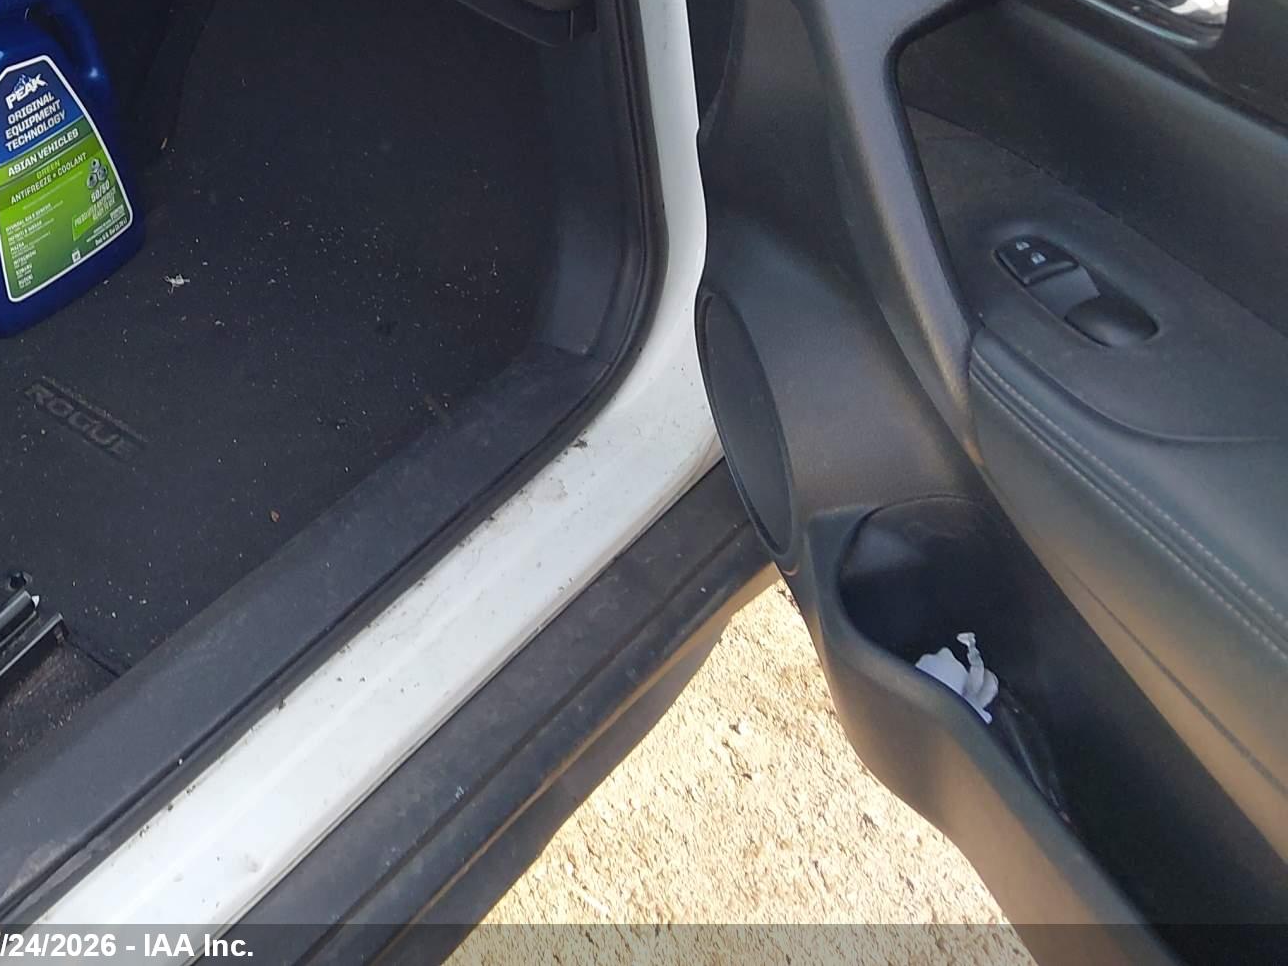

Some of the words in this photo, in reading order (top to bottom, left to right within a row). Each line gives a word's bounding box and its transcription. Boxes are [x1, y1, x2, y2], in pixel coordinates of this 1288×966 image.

[5, 74, 48, 109] PEAK
[7, 92, 55, 125] ORIGINAL
[5, 99, 61, 139] EQUIPMENT
[5, 109, 65, 152] TECHNOLOGY
[8, 153, 38, 177] ASIAN
[37, 128, 79, 160] VEHICLES
[11, 175, 52, 204] ANTIFREEZE
[57, 152, 87, 176] COOLANT
